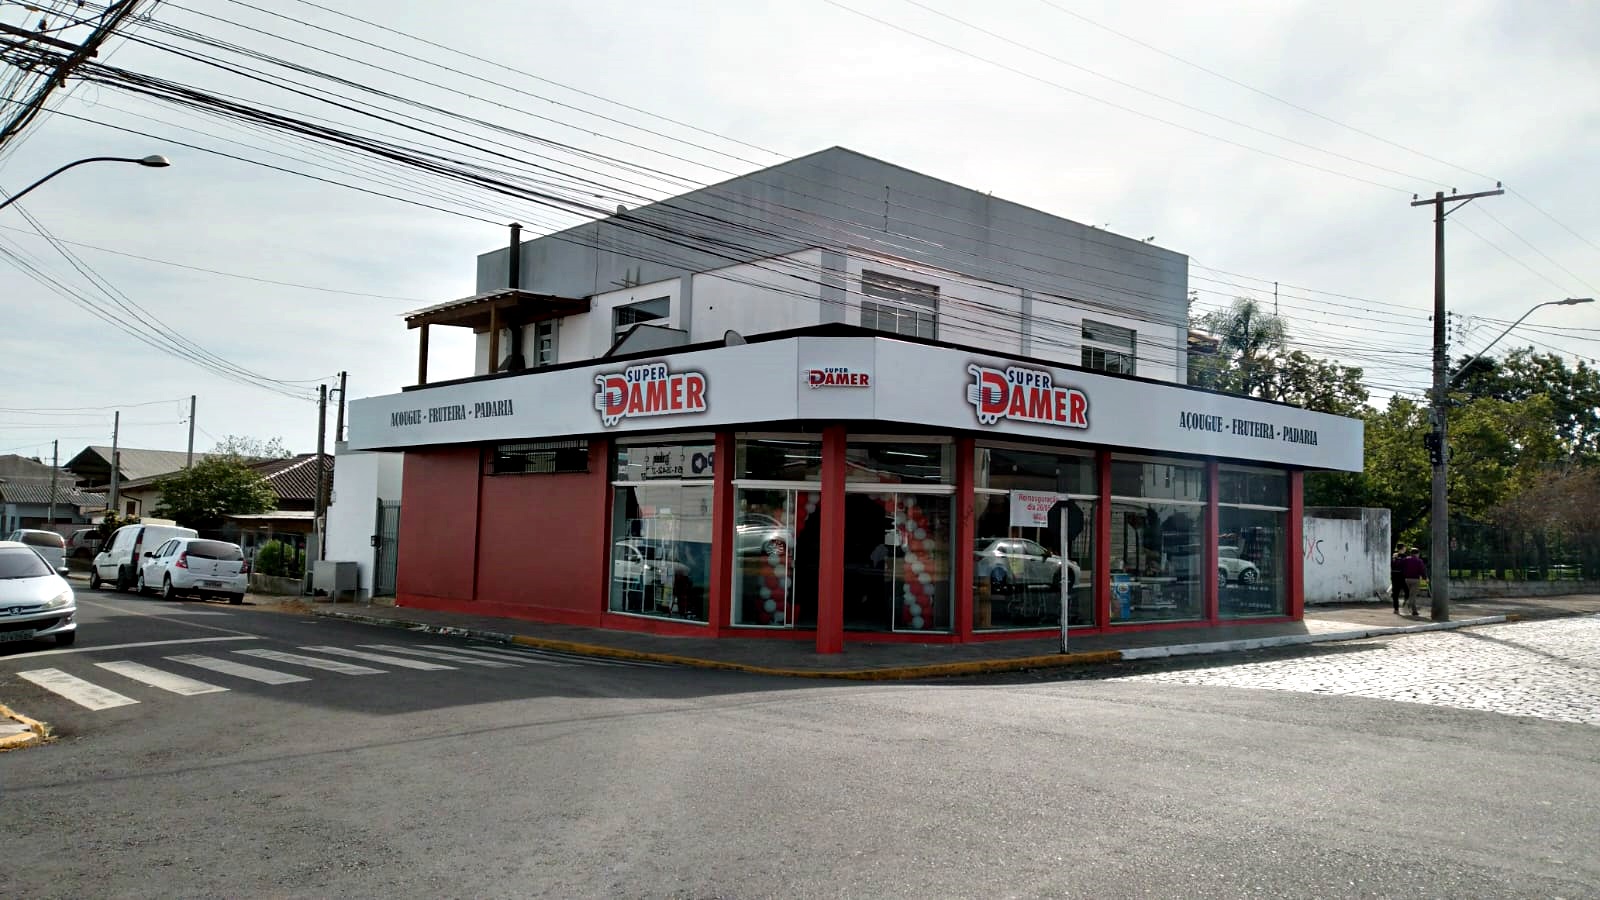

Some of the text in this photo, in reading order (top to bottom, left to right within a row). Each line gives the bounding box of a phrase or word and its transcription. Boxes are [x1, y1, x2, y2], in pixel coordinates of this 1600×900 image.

[627, 366, 666, 383] SUPER
[810, 369, 870, 385] DAMER
[1008, 369, 1050, 389] SUPER
[606, 376, 704, 416] DAMER
[982, 371, 1087, 425] DAMER
[391, 409, 422, 428] AÇOUGUE
[428, 404, 466, 423] FRUTEIRA
[474, 399, 514, 419] PADARIA
[1179, 411, 1223, 433] AÇOUGUE
[1231, 418, 1275, 440] FRUTEIRA
[1282, 425, 1318, 446] PADARIA
